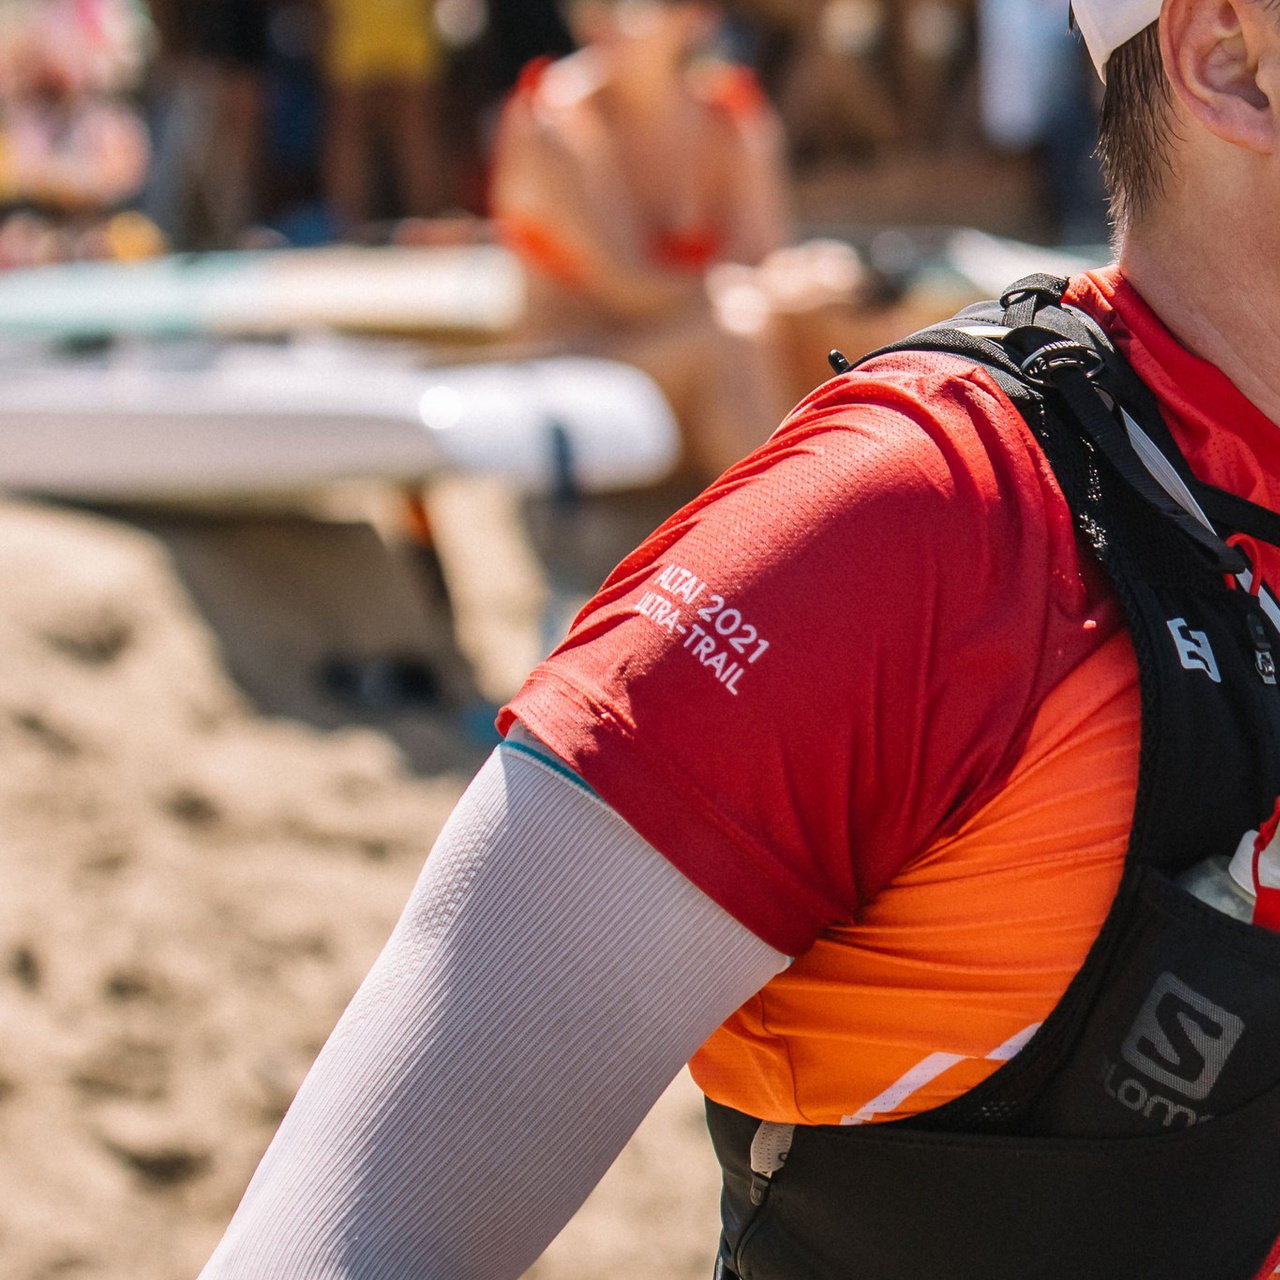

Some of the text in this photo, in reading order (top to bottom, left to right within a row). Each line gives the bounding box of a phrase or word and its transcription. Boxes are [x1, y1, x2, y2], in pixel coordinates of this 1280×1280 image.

[635, 591, 745, 696] ULTRA-TRAIL
[654, 563, 770, 663] ALTAI 2021
